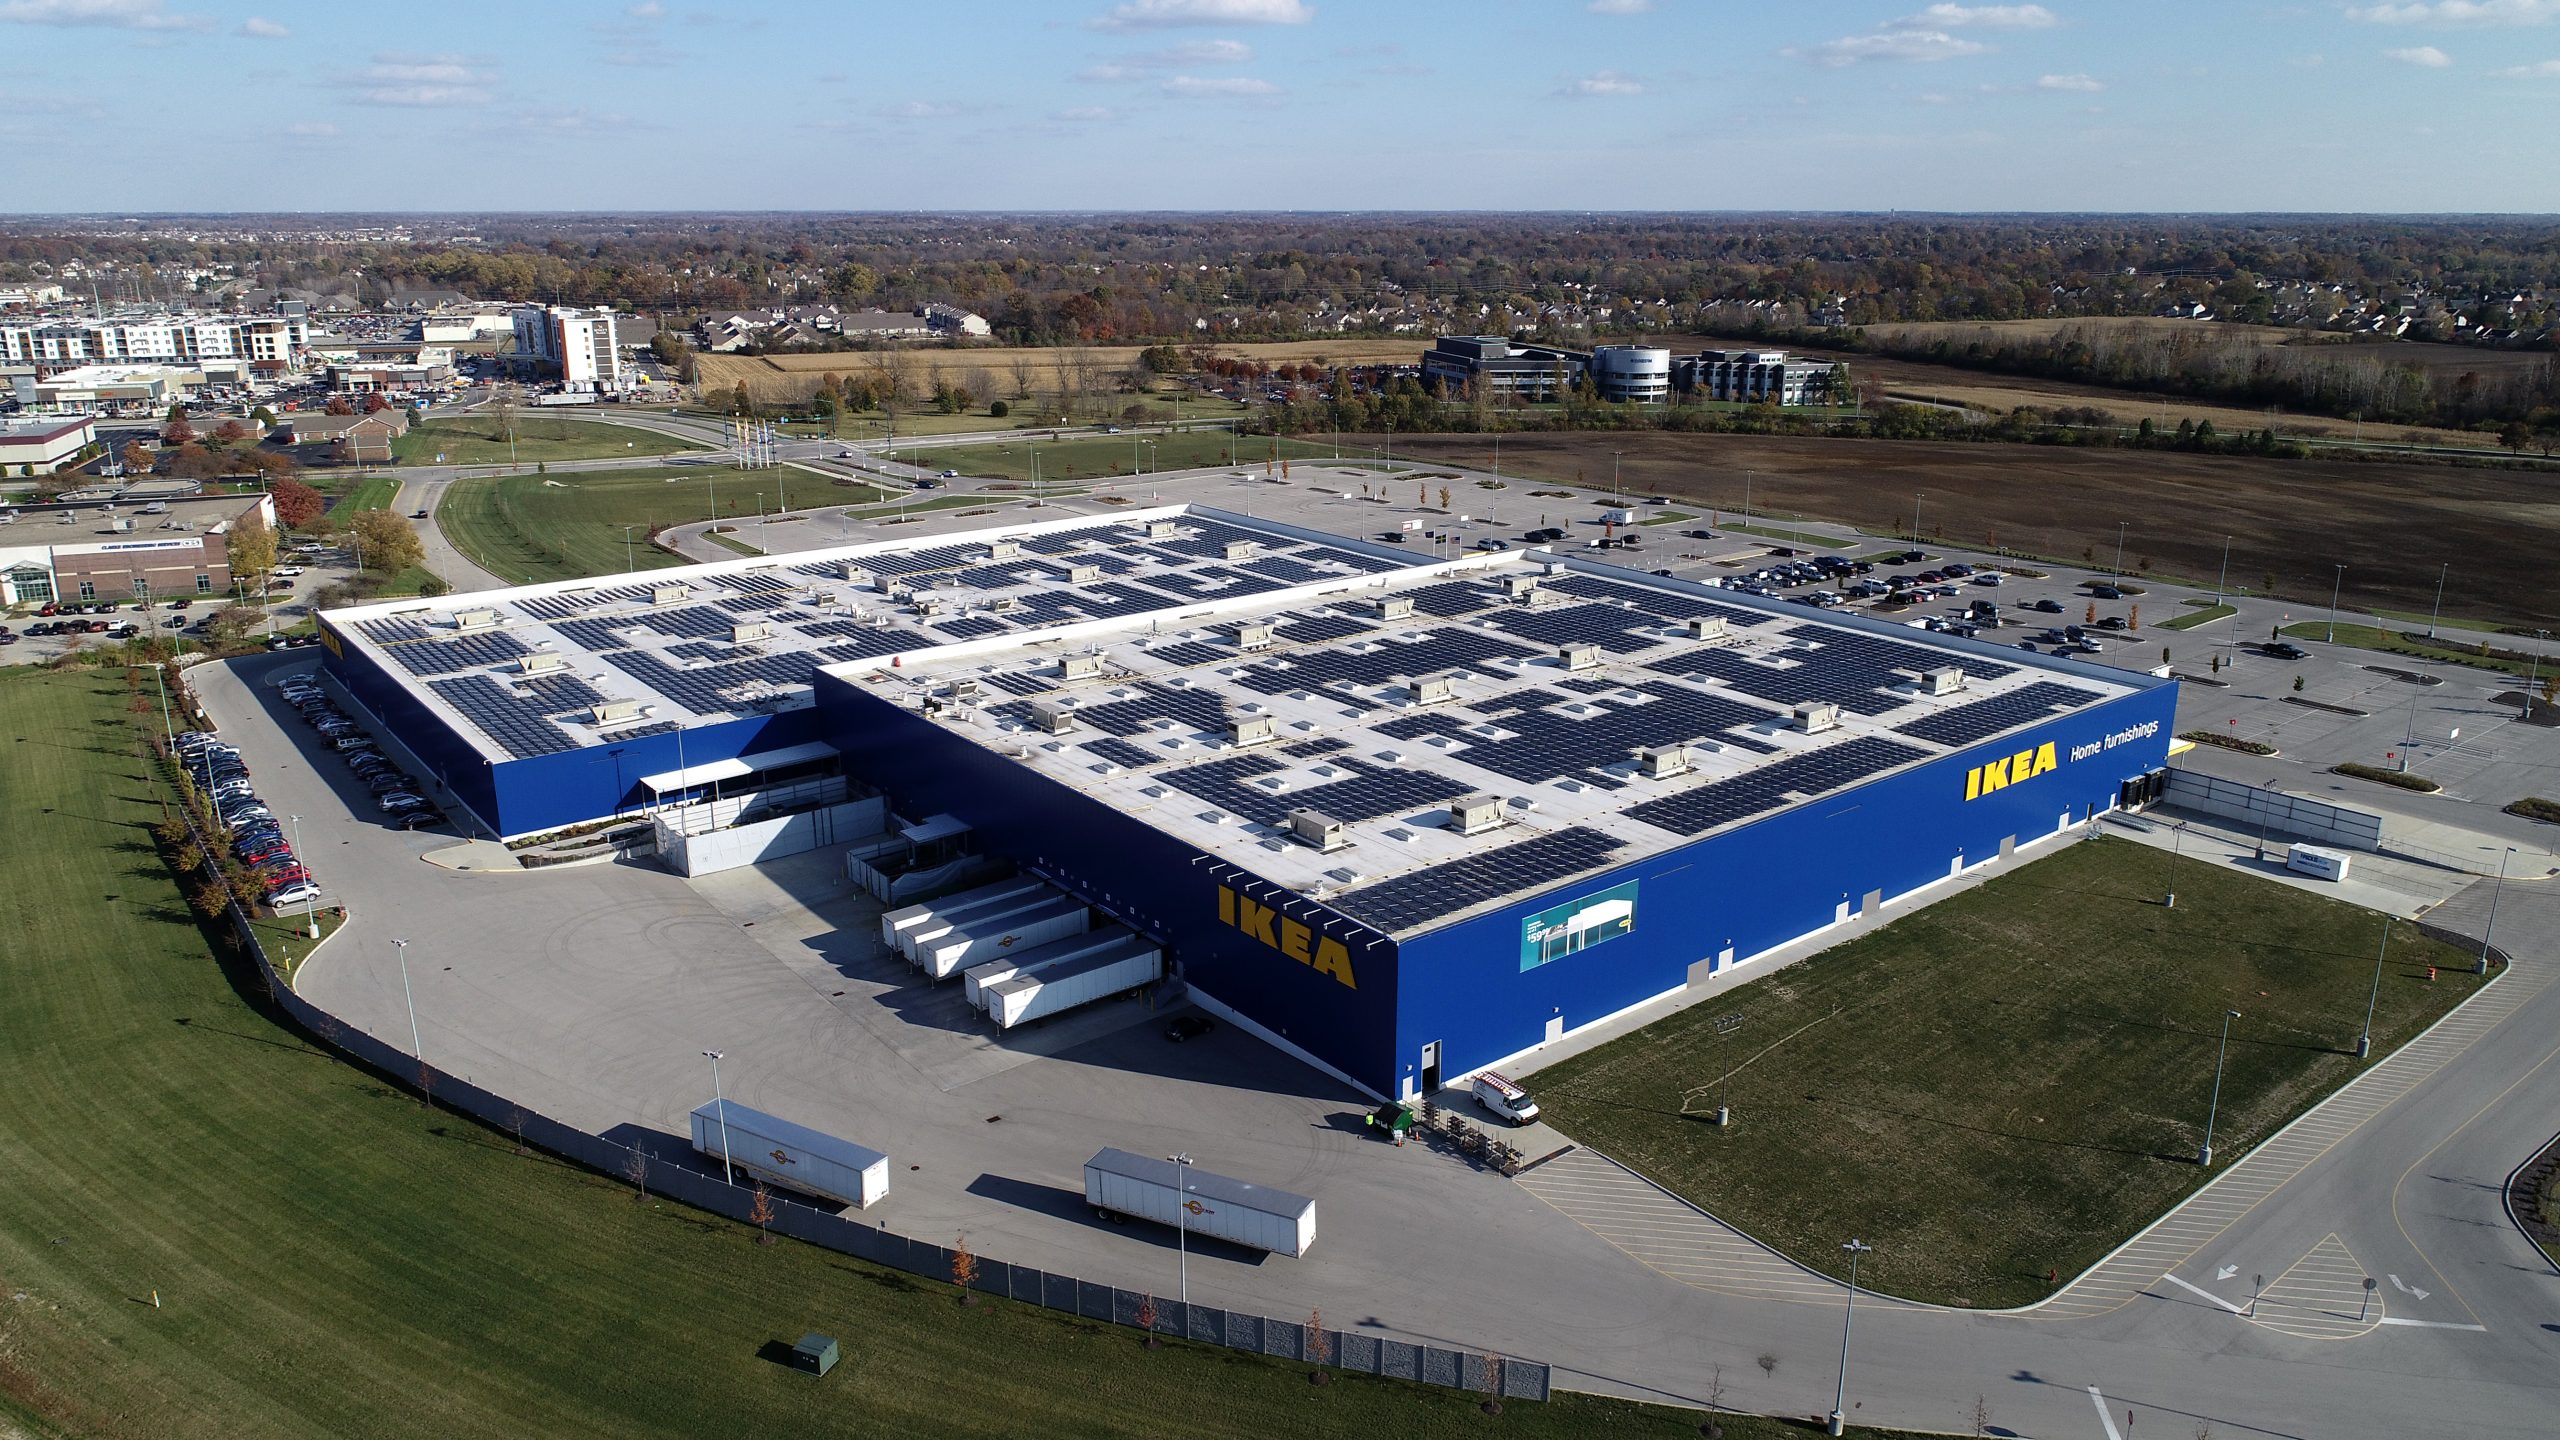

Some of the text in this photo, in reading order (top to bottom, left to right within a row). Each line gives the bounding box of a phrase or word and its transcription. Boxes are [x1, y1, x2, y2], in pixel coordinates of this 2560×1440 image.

[1965, 720, 2159, 802] IKEA Home furnishings
[1218, 884, 1357, 990] IKEA
